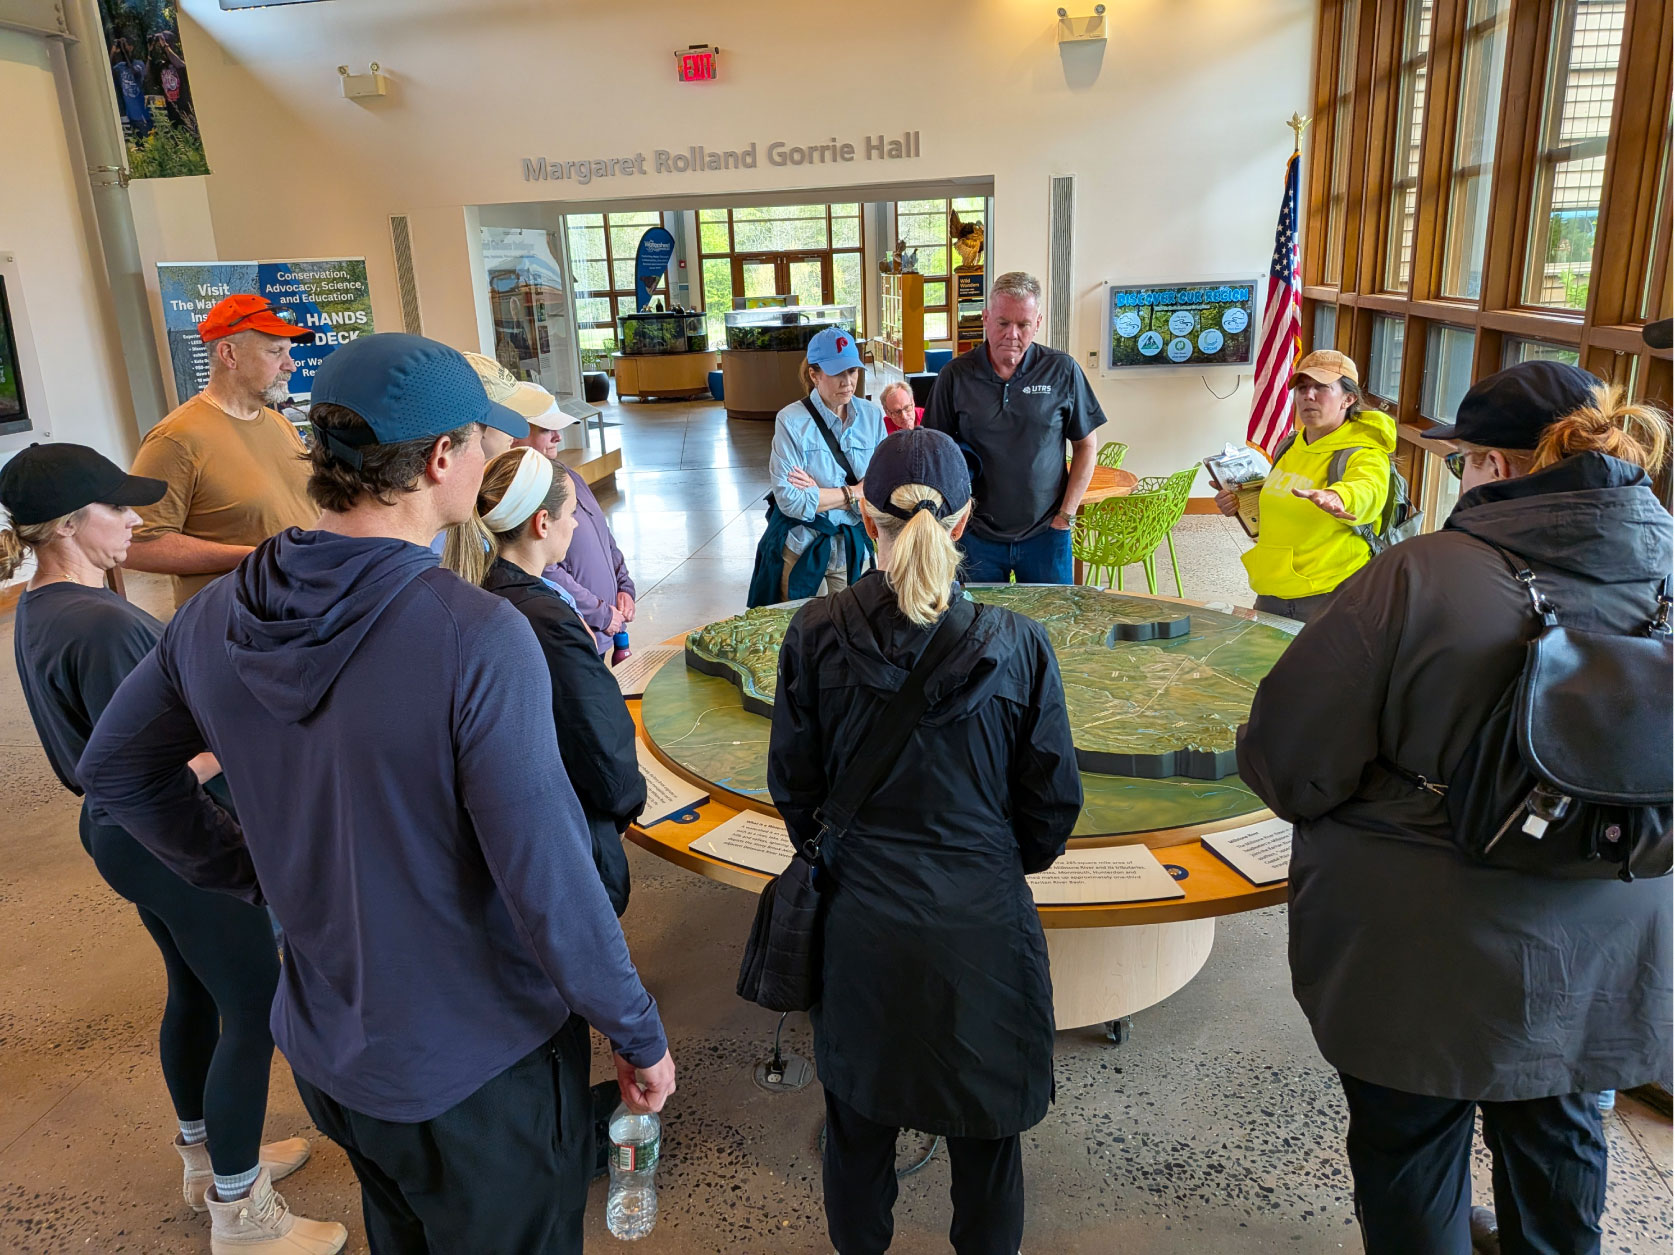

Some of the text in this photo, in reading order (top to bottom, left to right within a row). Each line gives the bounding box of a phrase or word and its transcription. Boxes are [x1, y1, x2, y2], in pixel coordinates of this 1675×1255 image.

[682, 53, 712, 82] EXIT
[521, 131, 921, 185] Margaret Rolland Gorrie Hall
[277, 270, 350, 281] Conservation,
[197, 283, 231, 296] Visit
[265, 281, 365, 294] Advocacy, Science,
[170, 300, 194, 311] The
[280, 293, 354, 304] and Education
[1117, 288, 1249, 307] DISCOVER OUR REGION
[306, 311, 368, 327] HANDS
[315, 330, 360, 346] DECK
[836, 336, 848, 353] P
